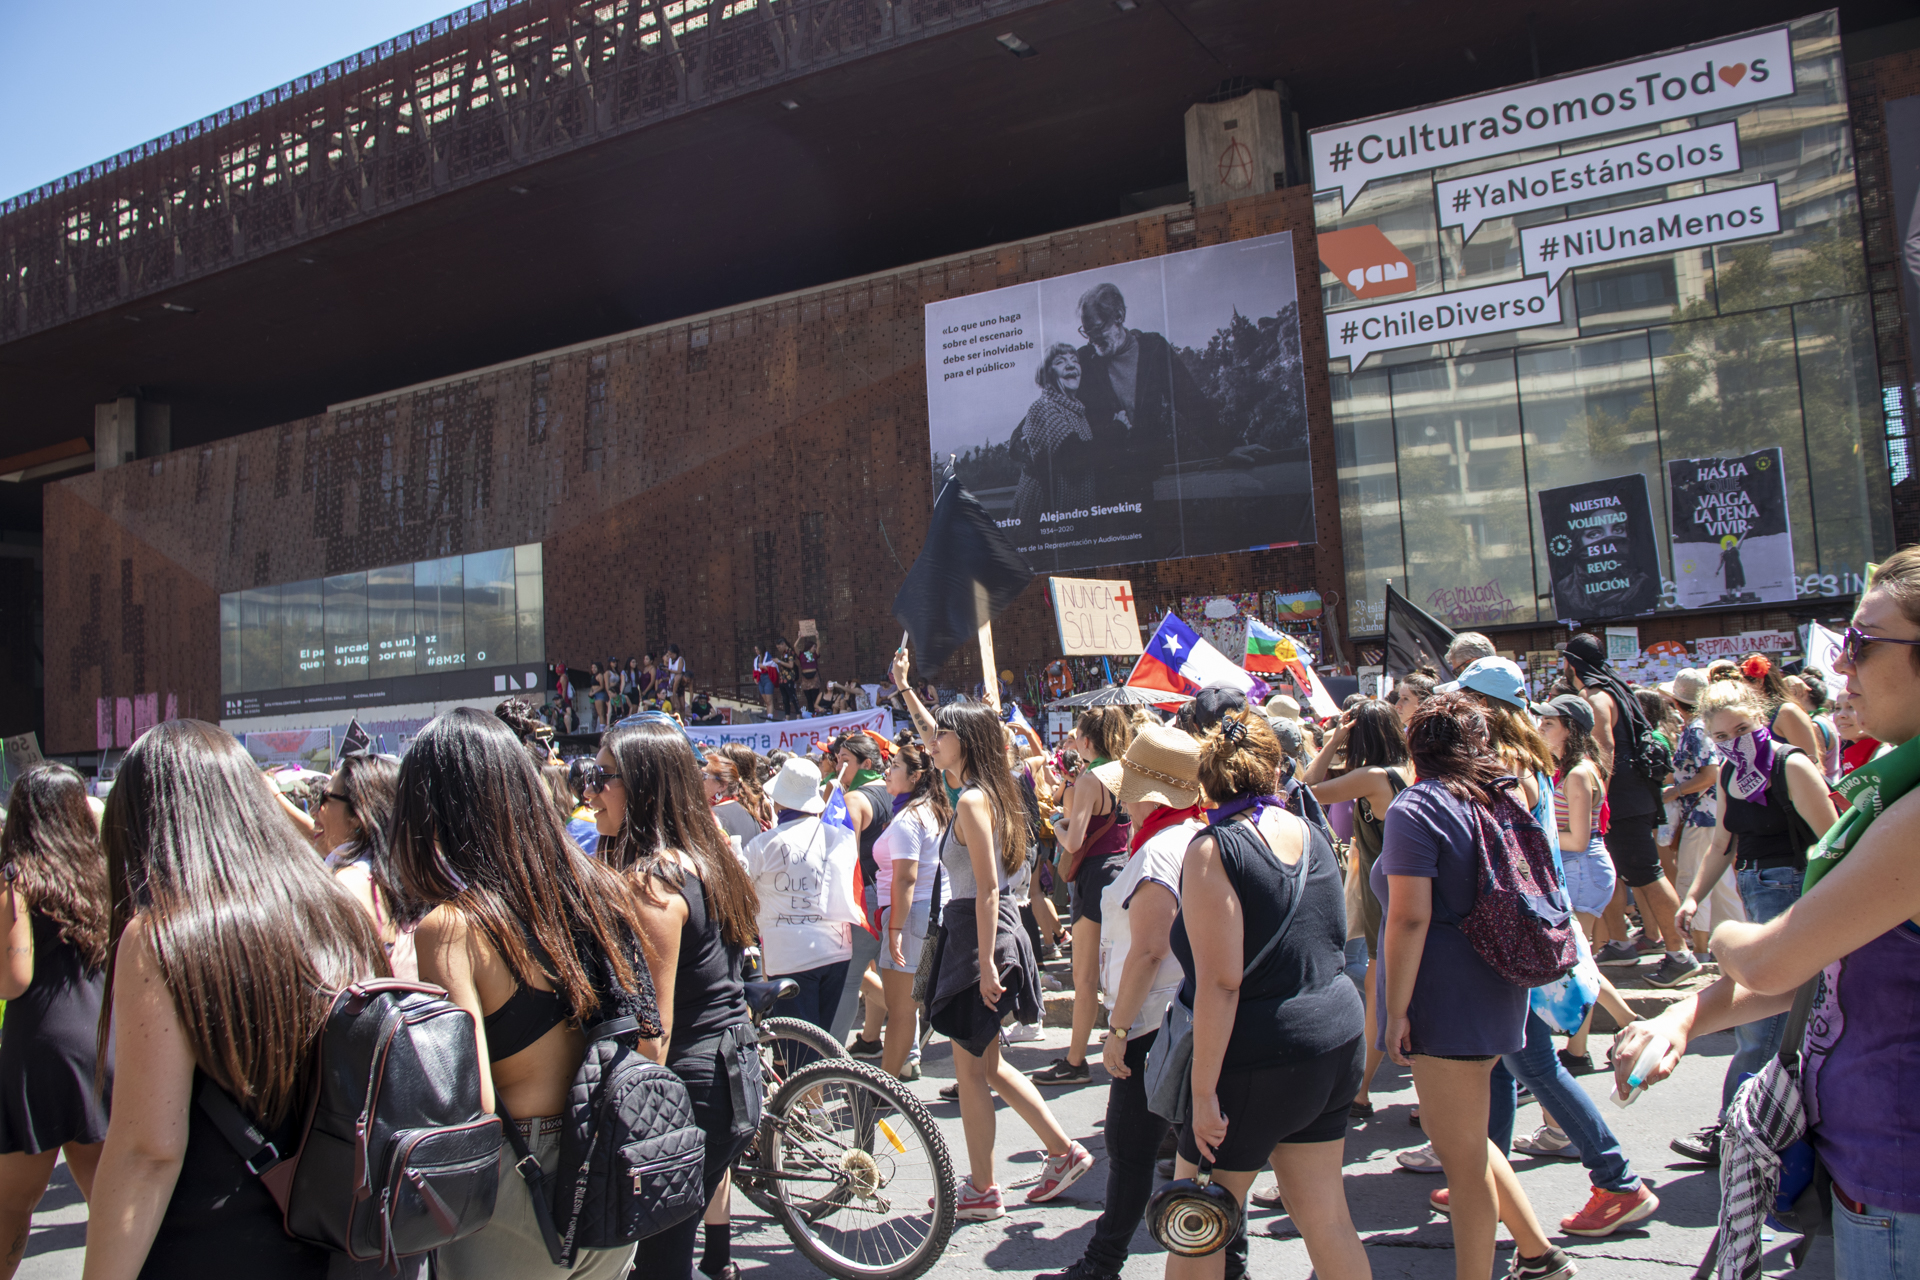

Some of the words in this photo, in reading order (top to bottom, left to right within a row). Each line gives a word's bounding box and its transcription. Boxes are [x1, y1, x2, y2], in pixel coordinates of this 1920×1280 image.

[1451, 139, 1724, 214] #YaNoEstánSolos
[1538, 204, 1765, 263] #NiUnaMenos
[961, 322, 977, 332] que
[979, 318, 997, 327] uno
[999, 313, 1021, 323] haga
[1339, 293, 1546, 345] #ChileDiverso
[942, 340, 967, 350] sobre
[969, 335, 977, 344] el
[979, 327, 1023, 342] escenario
[943, 354, 965, 365] debe
[967, 351, 981, 361] ser
[983, 340, 1034, 357] inolvidable
[943, 370, 964, 382] para
[966, 366, 974, 376] el
[1697, 461, 1749, 482] HASTA
[1705, 476, 1742, 493] QUE
[1569, 495, 1622, 514] NUESTRA
[1698, 491, 1751, 509] VALGA
[993, 516, 1022, 529] astro
[1039, 508, 1089, 523] Alejandro
[1090, 501, 1142, 516] Sieveking
[1567, 512, 1628, 531] VOLUNTAD
[1693, 509, 1713, 524] LA
[1717, 504, 1760, 521] PENA
[1705, 519, 1750, 536] VIVIR
[1028, 544, 1037, 552] de
[1038, 543, 1044, 551] la
[1044, 537, 1092, 550] Representación
[1098, 532, 1143, 544] Audiovisuales
[1587, 544, 1600, 557] ES
[1602, 543, 1617, 555] LA
[1587, 559, 1622, 574] REVO-
[1585, 577, 1630, 595] LUCIÓN
[1061, 584, 1116, 611] NUNCA
[1355, 598, 1386, 618] Resist
[1064, 611, 1132, 650] SOLAS
[1353, 617, 1384, 632] Lucha
[300, 649, 310, 659] El
[379, 641, 393, 650] es
[395, 638, 410, 648] un
[411, 634, 437, 649] jez
[1697, 637, 1739, 656] REPTAN
[1741, 638, 1751, 651] &
[1750, 634, 1793, 650] RAPTAN
[300, 659, 320, 671] que
[774, 871, 809, 892] QUE
